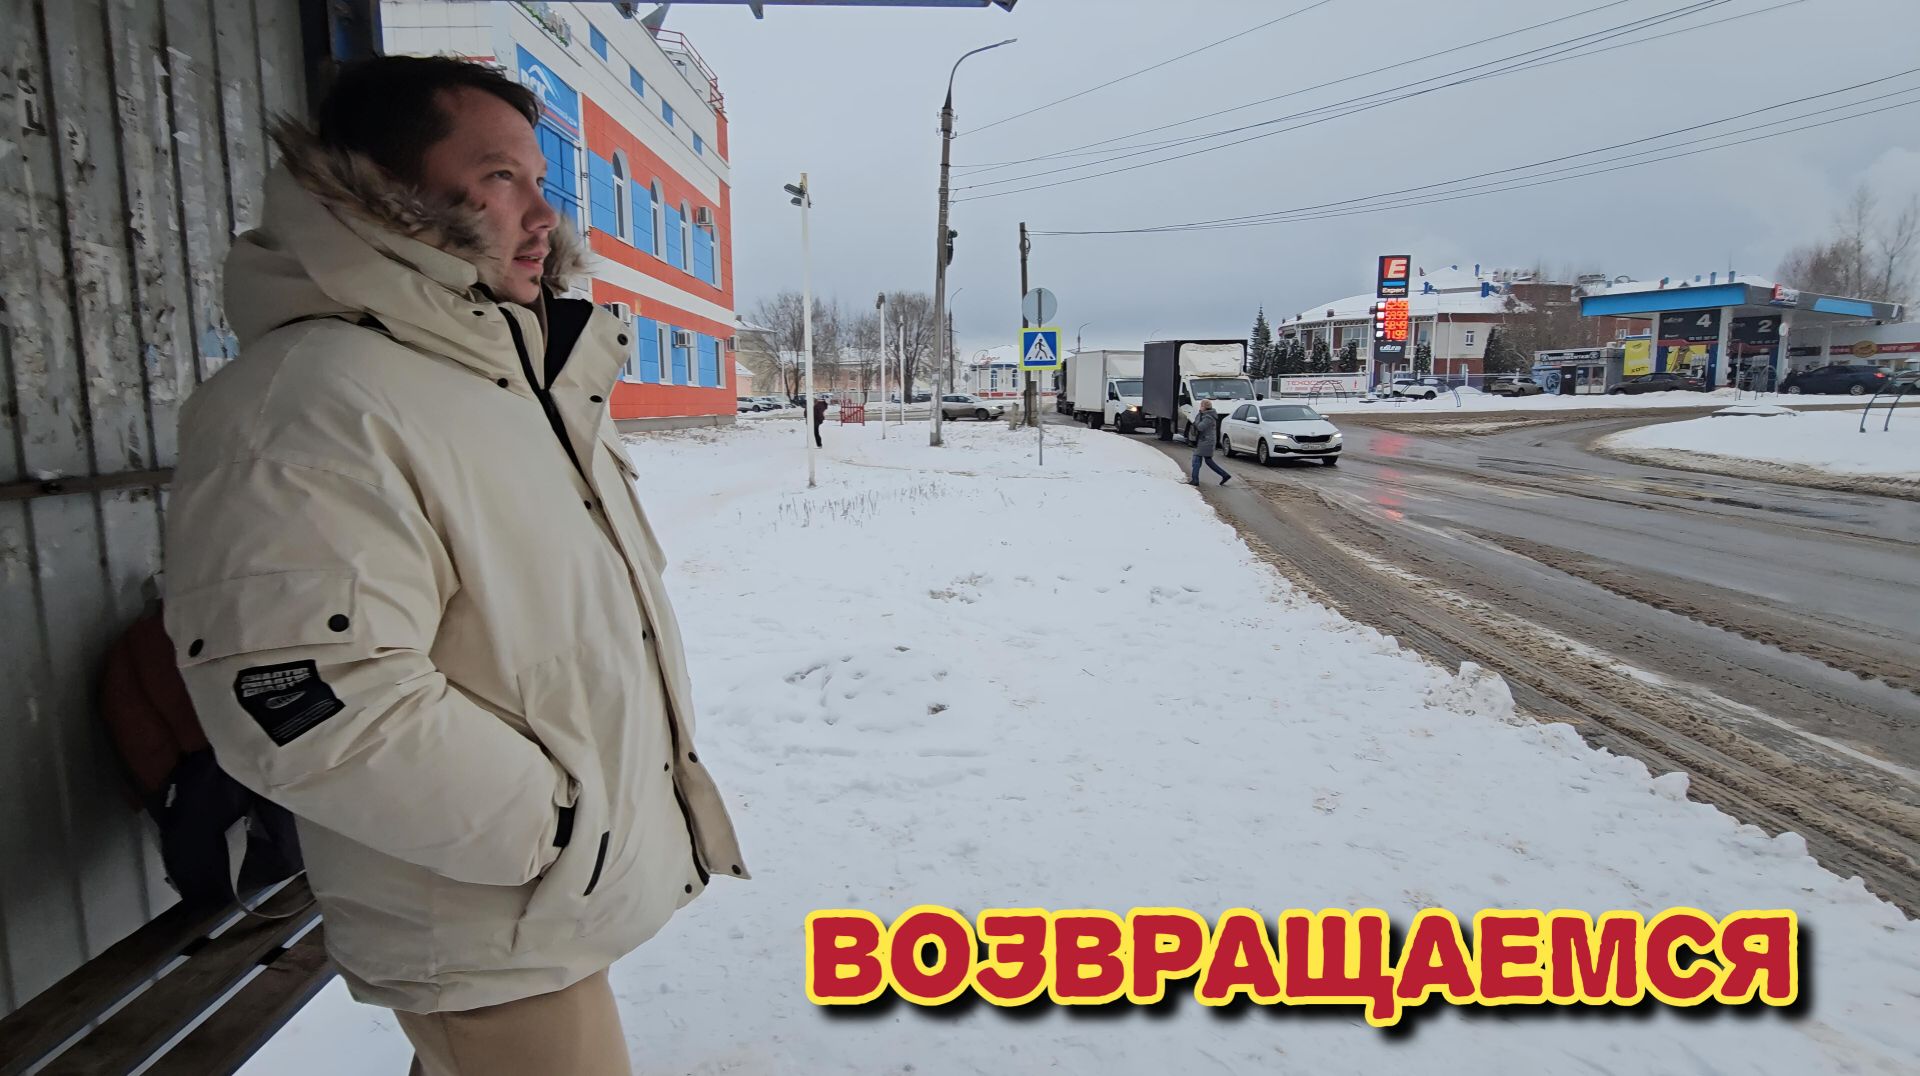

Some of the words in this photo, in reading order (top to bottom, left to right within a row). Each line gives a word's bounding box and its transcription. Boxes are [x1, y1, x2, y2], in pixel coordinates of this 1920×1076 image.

[1387, 259, 1407, 279] E
[1696, 314, 1712, 328] 4
[1758, 320, 1772, 333] 2
